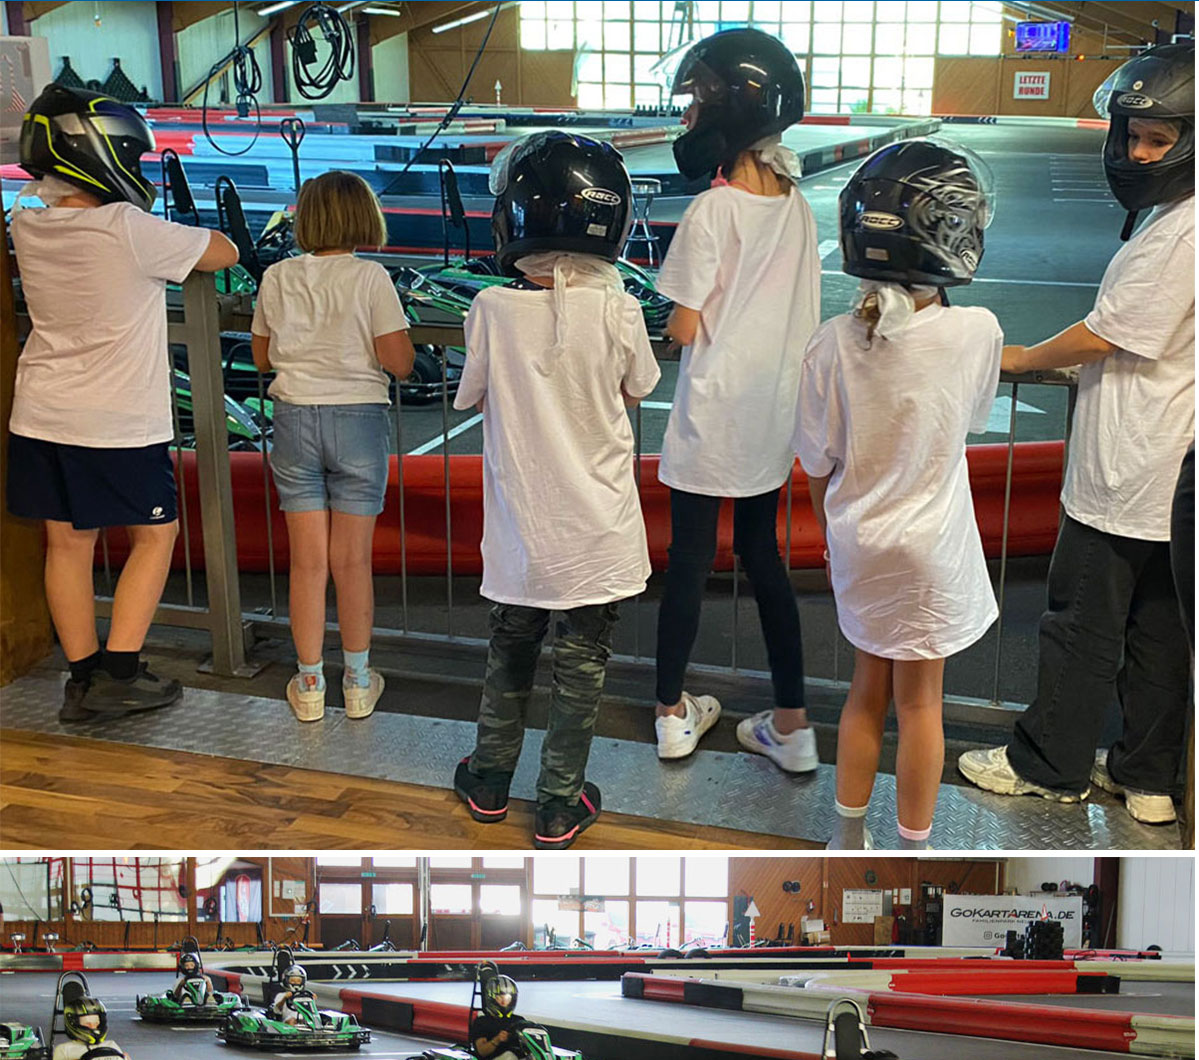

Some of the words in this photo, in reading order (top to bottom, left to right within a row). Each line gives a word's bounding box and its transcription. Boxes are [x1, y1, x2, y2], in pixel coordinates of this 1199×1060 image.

[1019, 75, 1046, 84] LETZTE
[1018, 86, 1045, 95] RUNDE
[860, 215, 899, 226] ROCC
